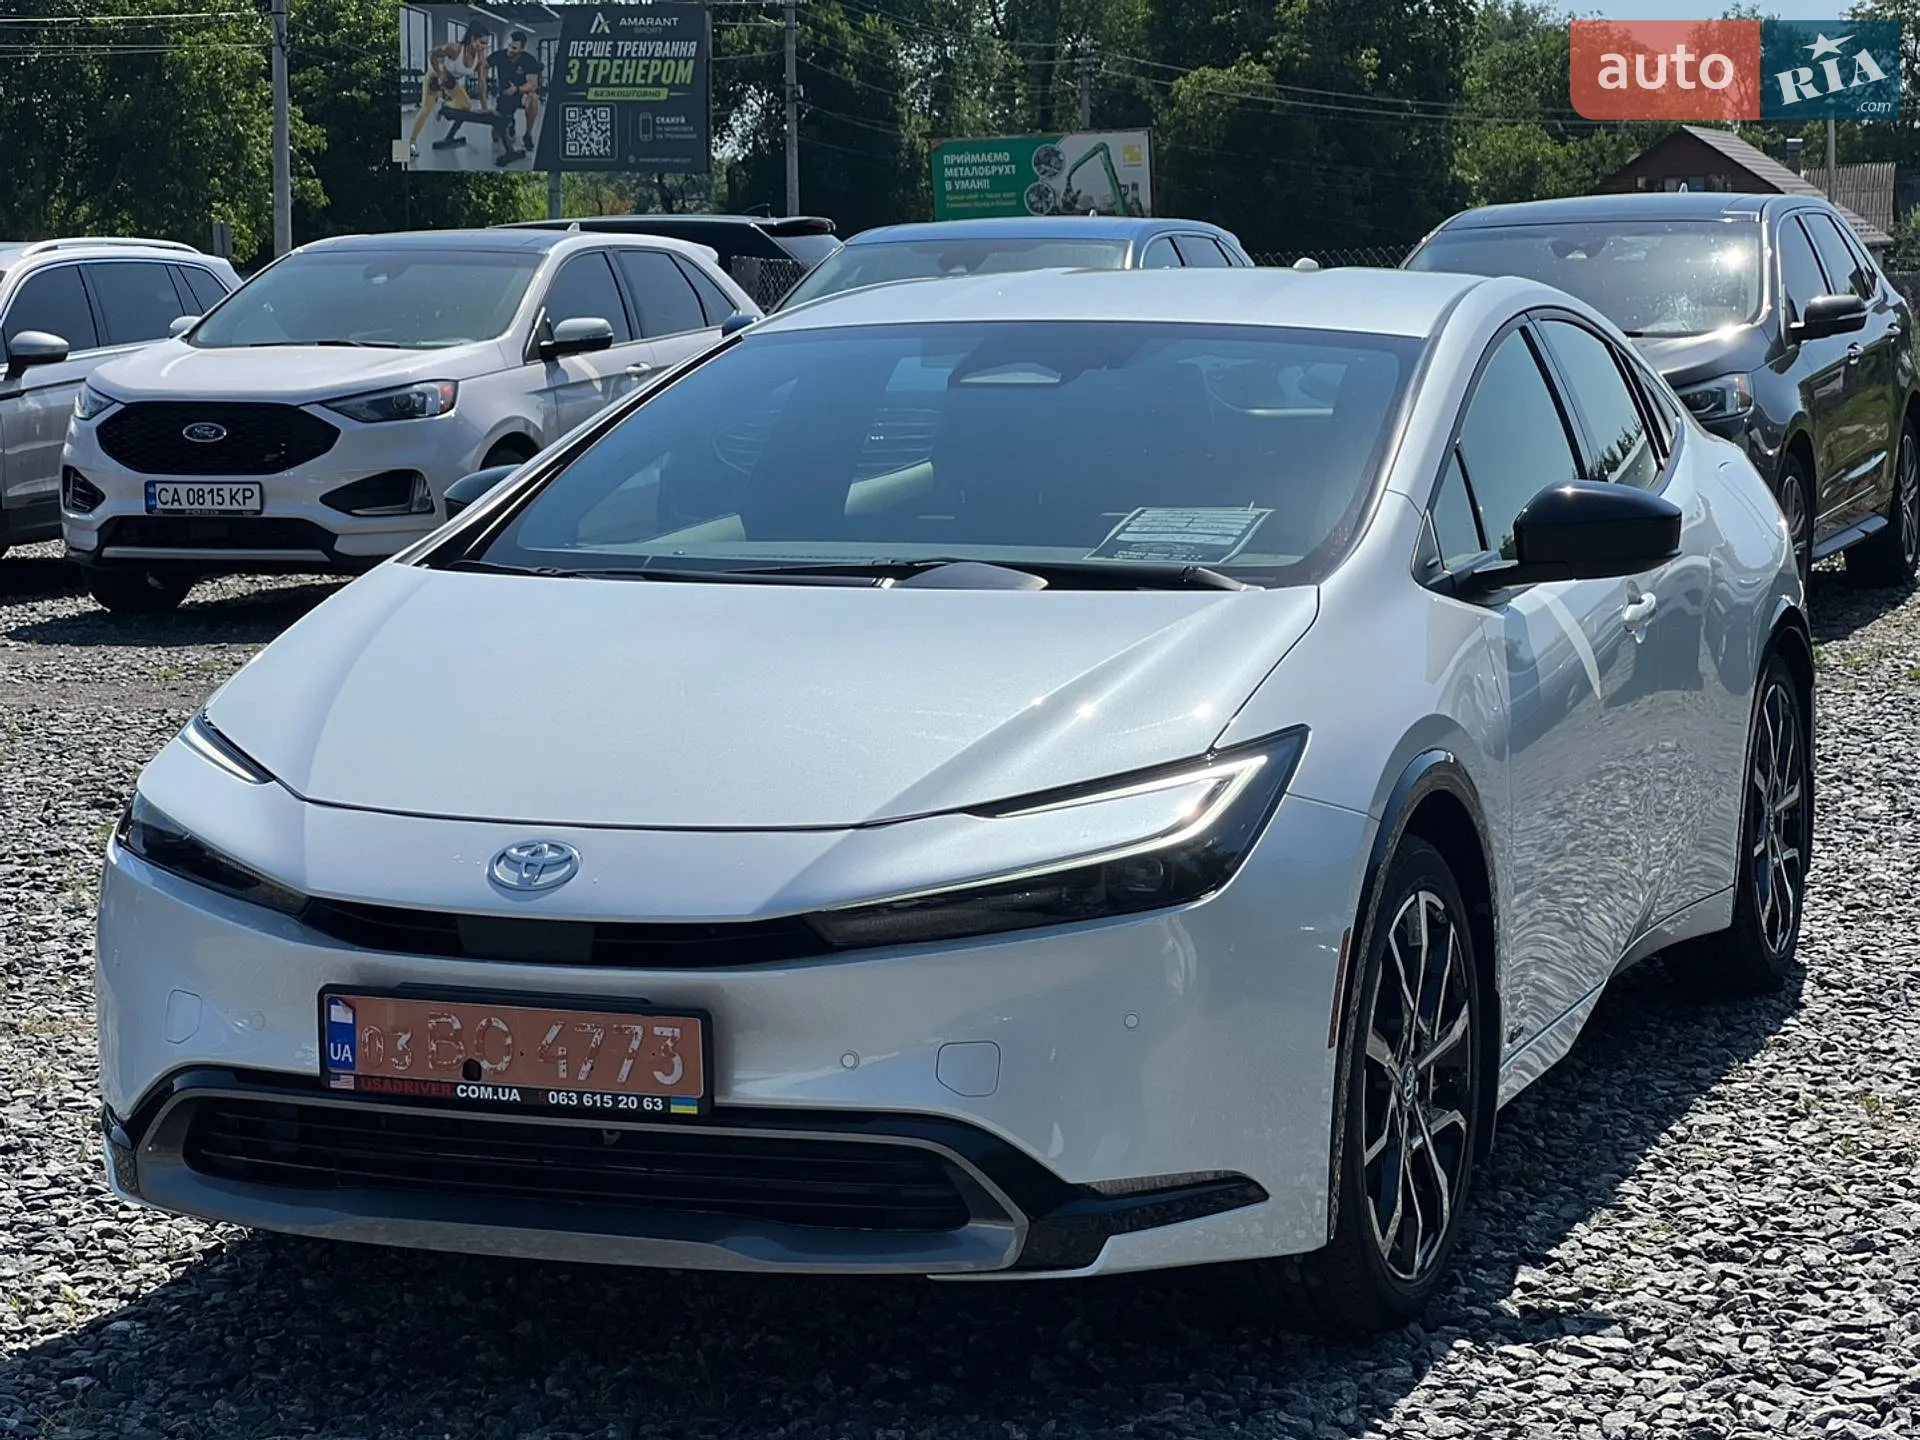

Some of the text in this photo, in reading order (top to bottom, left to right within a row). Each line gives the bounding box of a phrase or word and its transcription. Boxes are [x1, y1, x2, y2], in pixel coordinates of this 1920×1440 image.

[619, 17, 679, 26] AMARANT
[568, 40, 698, 58] ПЕРШЕ ТРЕНУВАННЯ
[565, 58, 695, 85] З ТРЕНЕРОМ
[593, 89, 662, 98] БЕЗКОШТОВНО
[655, 114, 686, 124] СКАНУЙ
[943, 152, 1011, 165] ПРИЙМАЄМО
[944, 165, 1016, 177] МЕТАЛОБРУХТ
[945, 180, 953, 191] В
[157, 487, 255, 506] CA 0815 KP
[330, 1042, 353, 1063] UA
[536, 1020, 685, 1086] 4773
[548, 1091, 664, 1111] 063 615 20 63
